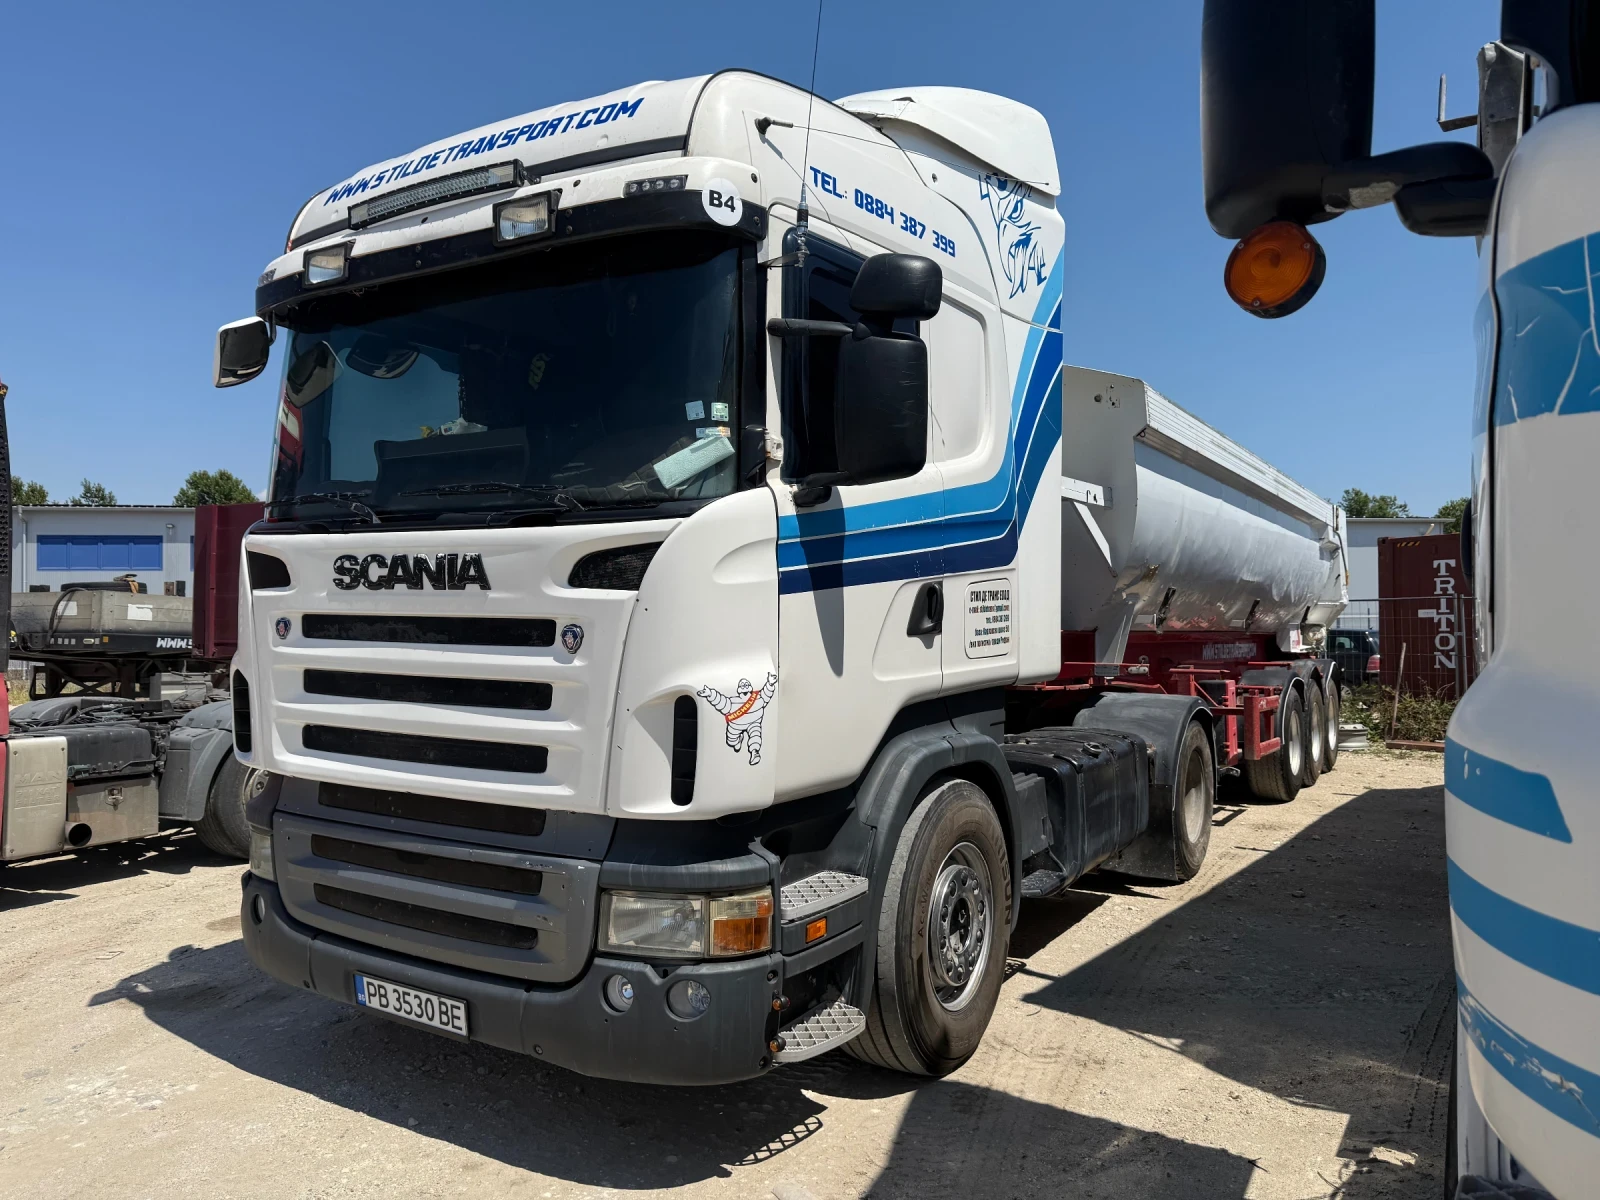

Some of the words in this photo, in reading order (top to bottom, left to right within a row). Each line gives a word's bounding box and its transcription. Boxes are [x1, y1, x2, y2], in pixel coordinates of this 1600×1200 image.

[323, 97, 645, 207] WWW.STILDETRANSPORT.COM
[708, 190, 736, 213] B4
[854, 188, 895, 225] 0884
[900, 211, 927, 240] 387
[932, 229, 956, 258] 399
[332, 552, 492, 591] SCANIA
[1432, 558, 1457, 669] TRITON
[728, 693, 756, 720] MICHELIN
[366, 981, 389, 1009] PB
[392, 988, 435, 1022] 3530
[438, 999, 463, 1031] BE
